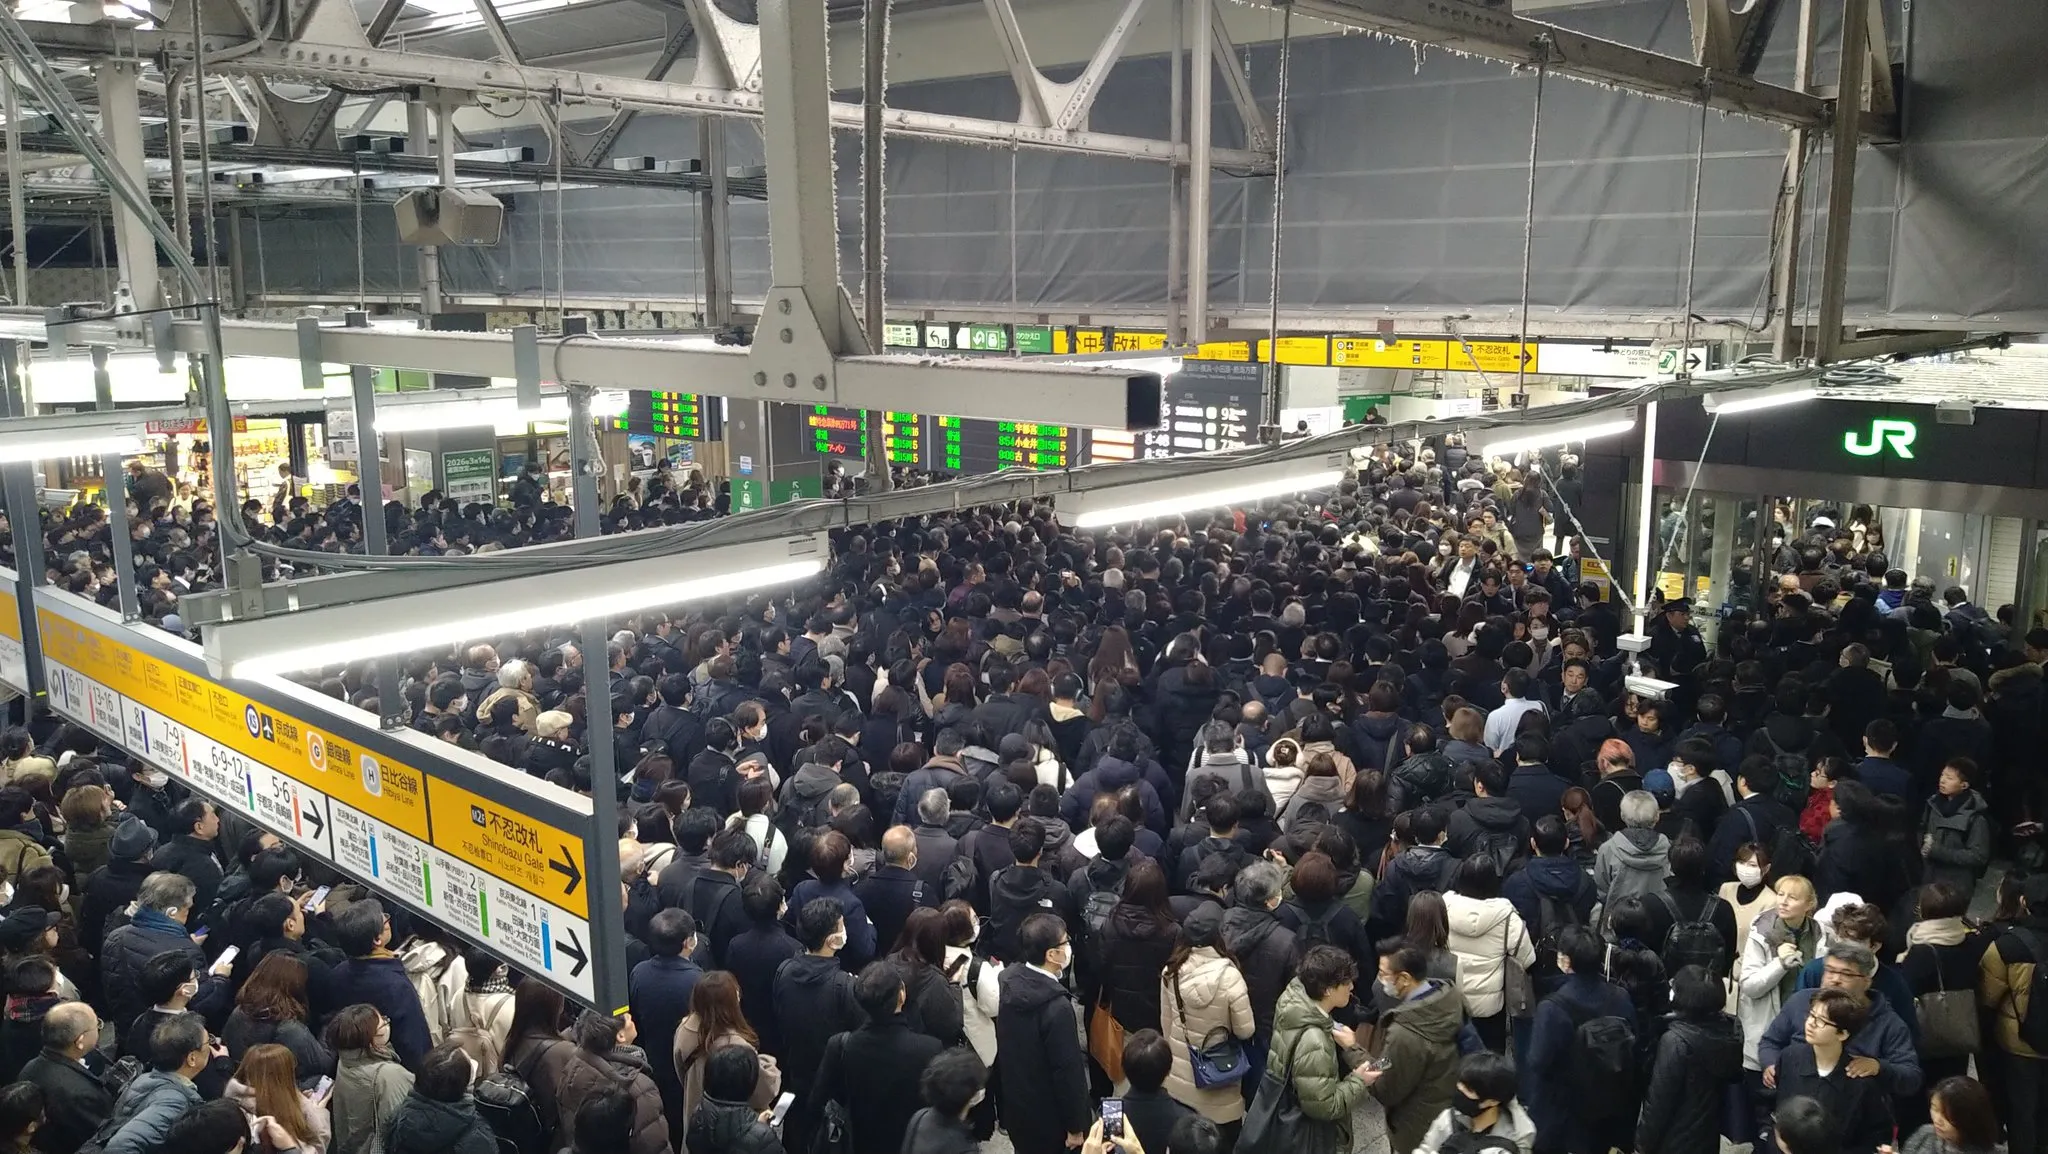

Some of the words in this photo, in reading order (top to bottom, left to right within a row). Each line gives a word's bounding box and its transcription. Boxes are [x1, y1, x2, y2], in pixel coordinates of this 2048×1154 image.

[1476, 345, 1511, 355] 不忍改札
[912, 413, 918, 423] 6
[912, 427, 919, 437] 16
[1059, 427, 1068, 437] 13
[1844, 419, 1917, 459] JR
[1014, 437, 1037, 449] 小金井
[134, 706, 141, 727] 8
[274, 718, 298, 742] 京成線
[325, 740, 353, 766] 銀座線
[328, 760, 343, 775] Ginza
[343, 766, 356, 781] Line
[380, 765, 419, 796] 日比谷線
[383, 787, 400, 802] Hibiya
[401, 793, 414, 807] Line
[360, 819, 367, 836] 4
[488, 810, 543, 854] 不忍改札
[413, 844, 421, 862] 3
[481, 833, 523, 862] Shinobazu
[524, 852, 545, 872] Gate
[469, 872, 477, 891] 2
[499, 887, 527, 910] 京浜東北線
[530, 903, 537, 921] 1
